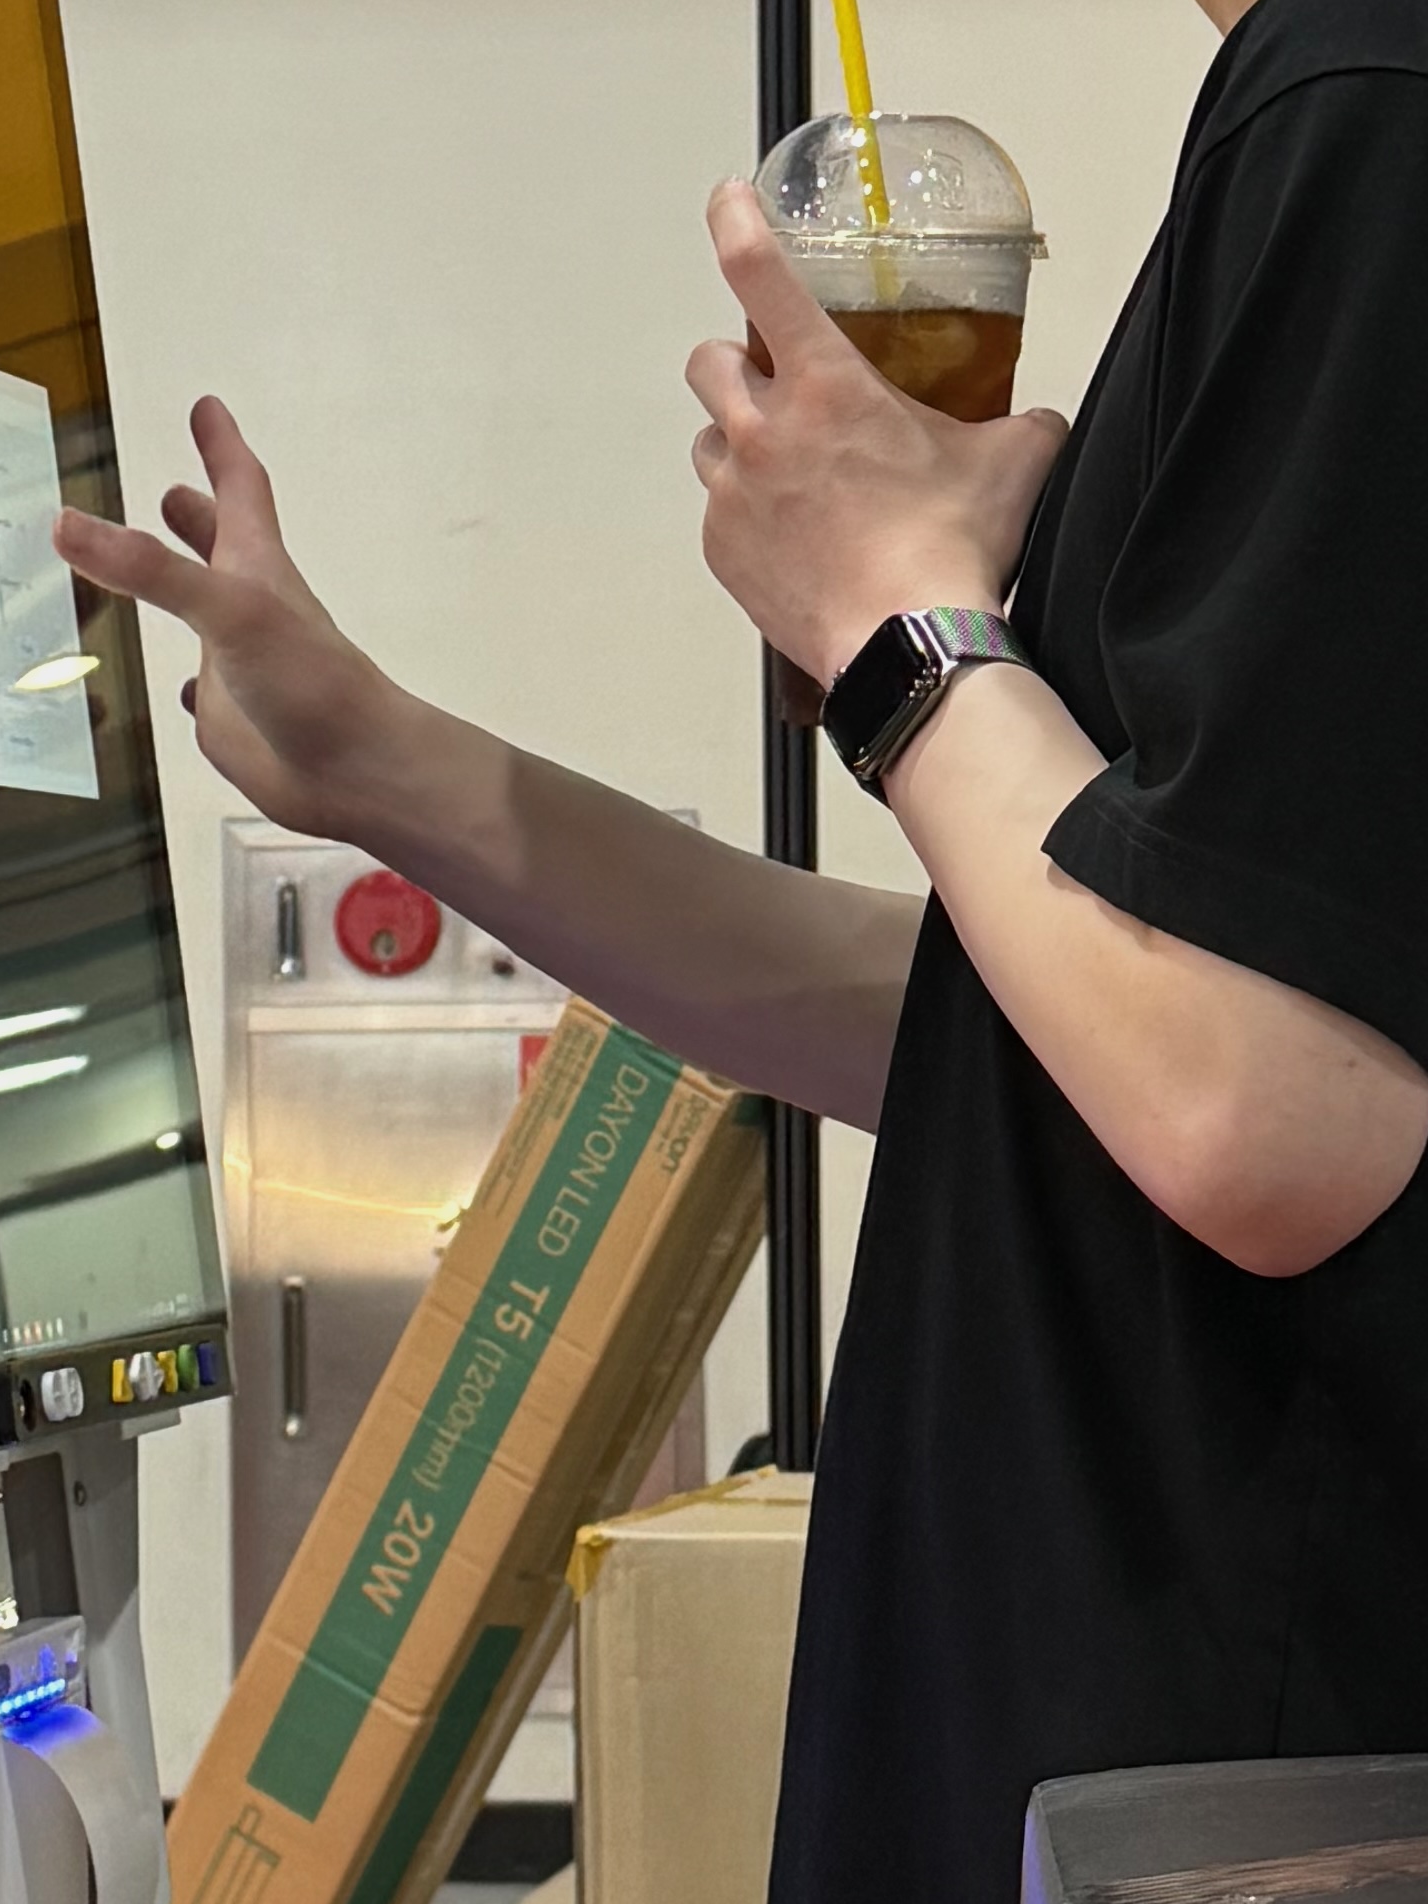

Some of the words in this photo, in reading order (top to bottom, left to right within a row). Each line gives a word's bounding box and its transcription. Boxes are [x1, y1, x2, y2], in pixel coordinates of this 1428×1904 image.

[569, 1063, 650, 1190] DAYON
[537, 1186, 591, 1257] LED
[493, 1279, 551, 1341] T5
[412, 1337, 509, 1492] (1200mm)
[361, 1498, 436, 1616] 20W
